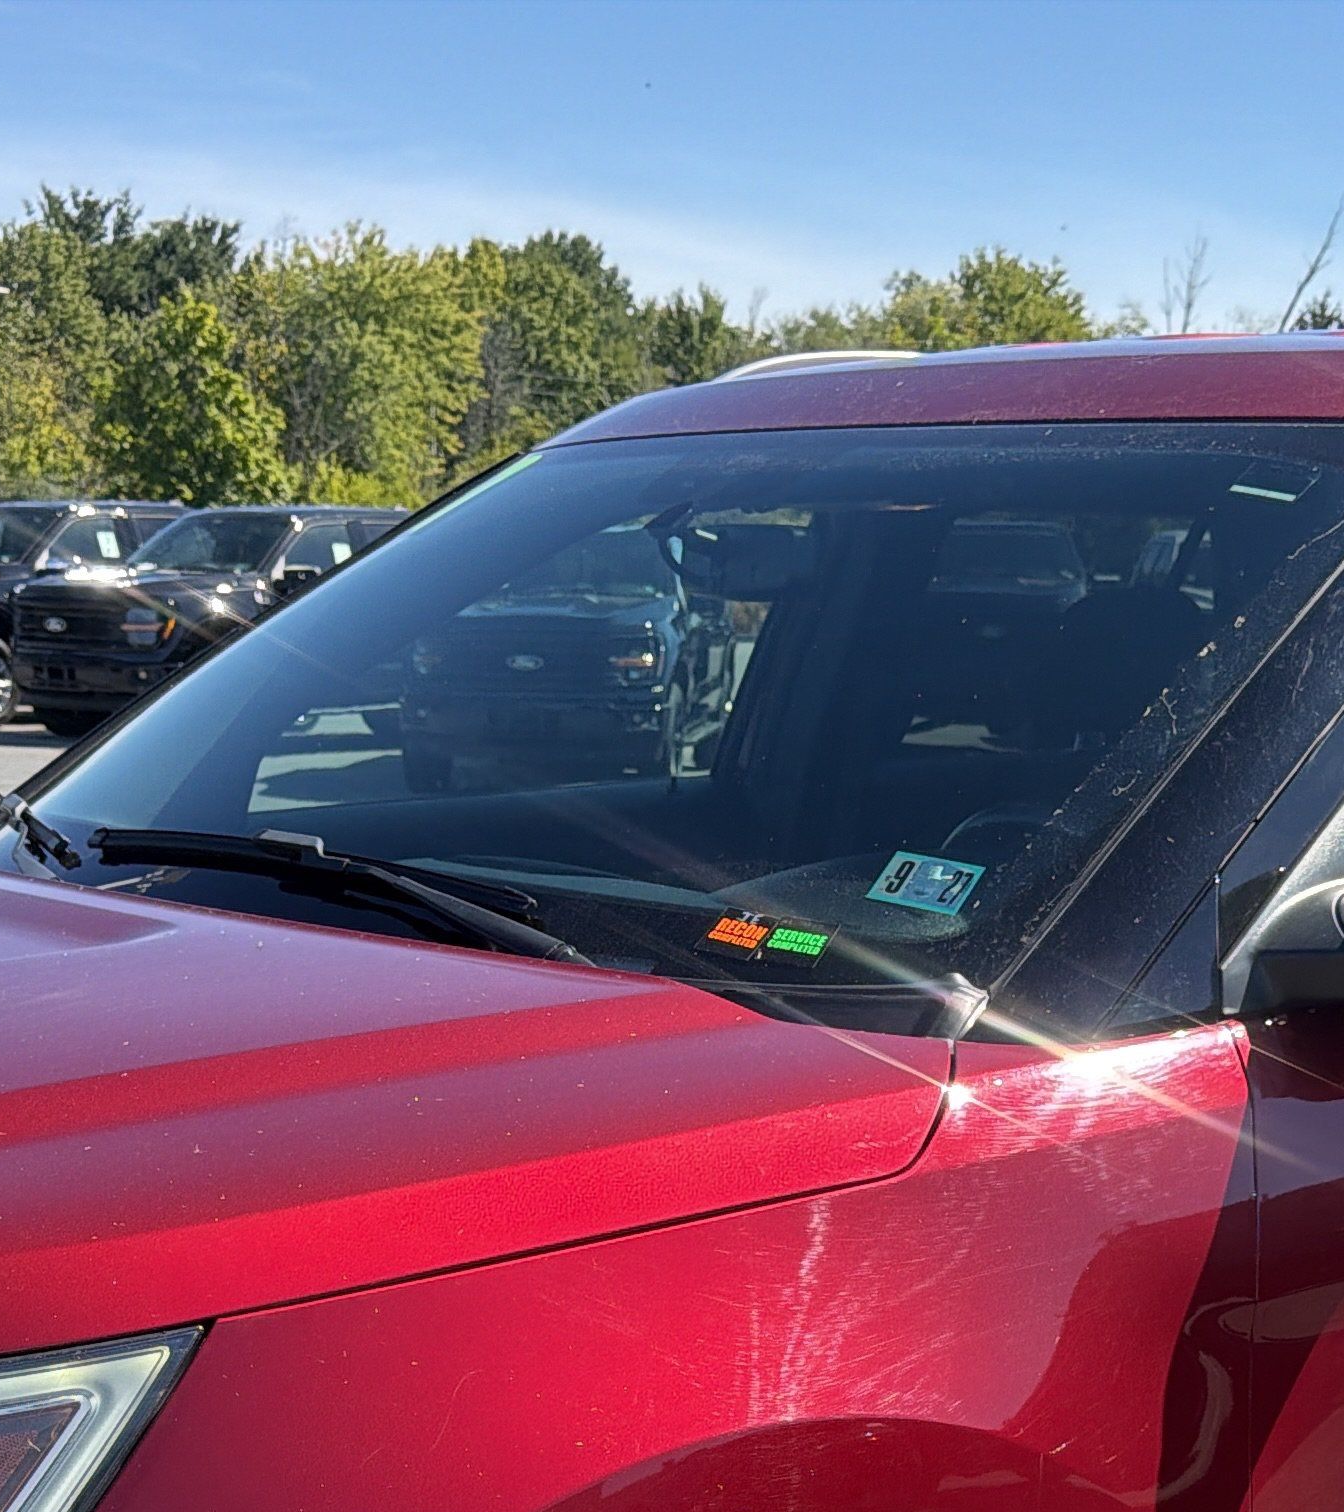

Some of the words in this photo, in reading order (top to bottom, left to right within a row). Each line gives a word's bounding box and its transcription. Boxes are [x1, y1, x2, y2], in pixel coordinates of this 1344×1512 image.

[885, 861, 916, 894] 9
[716, 917, 769, 940] RECON
[772, 928, 828, 946] SERVICE
